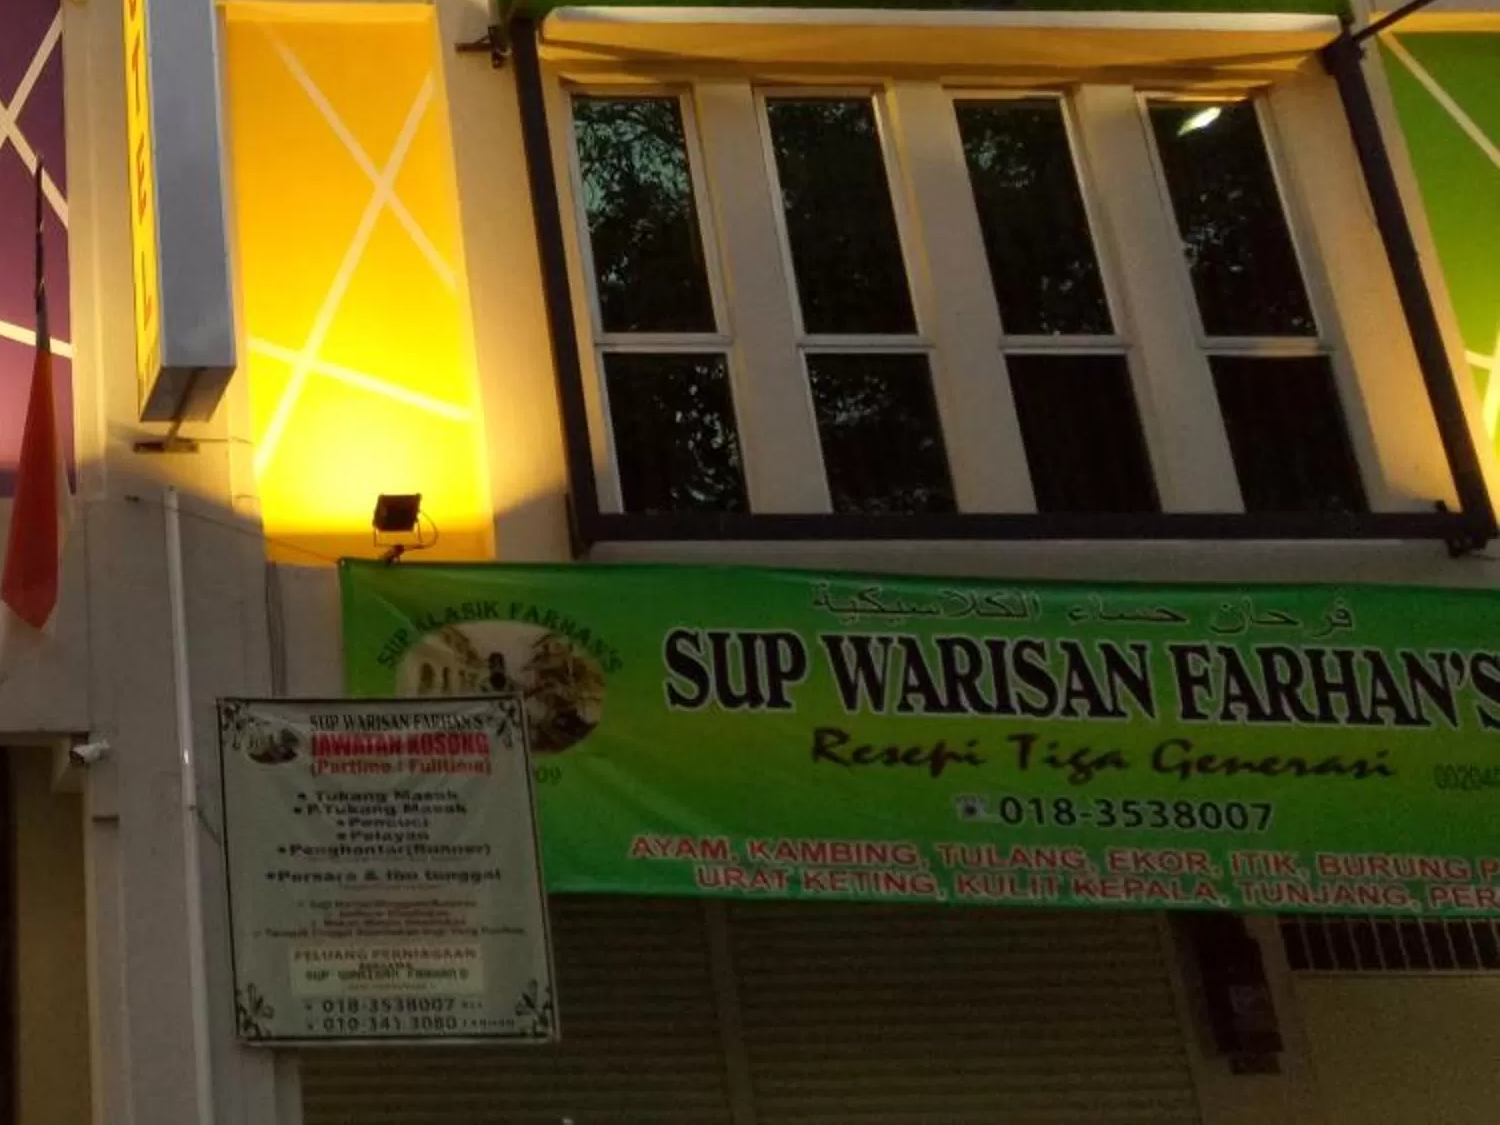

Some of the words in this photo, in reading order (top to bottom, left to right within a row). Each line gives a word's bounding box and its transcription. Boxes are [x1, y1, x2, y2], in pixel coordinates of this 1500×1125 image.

[662, 626, 808, 714] SUP
[820, 629, 1159, 722] WARISAN
[1167, 640, 1500, 732] FARHAN'S
[812, 726, 988, 775] Resepi
[1005, 732, 1130, 786] Tiga
[1151, 737, 1397, 781] Generasi
[999, 794, 1276, 832] 018-3538007
[696, 866, 791, 893] URAT
[957, 875, 1062, 901] KULIT
[1315, 852, 1471, 882] BURUNG
